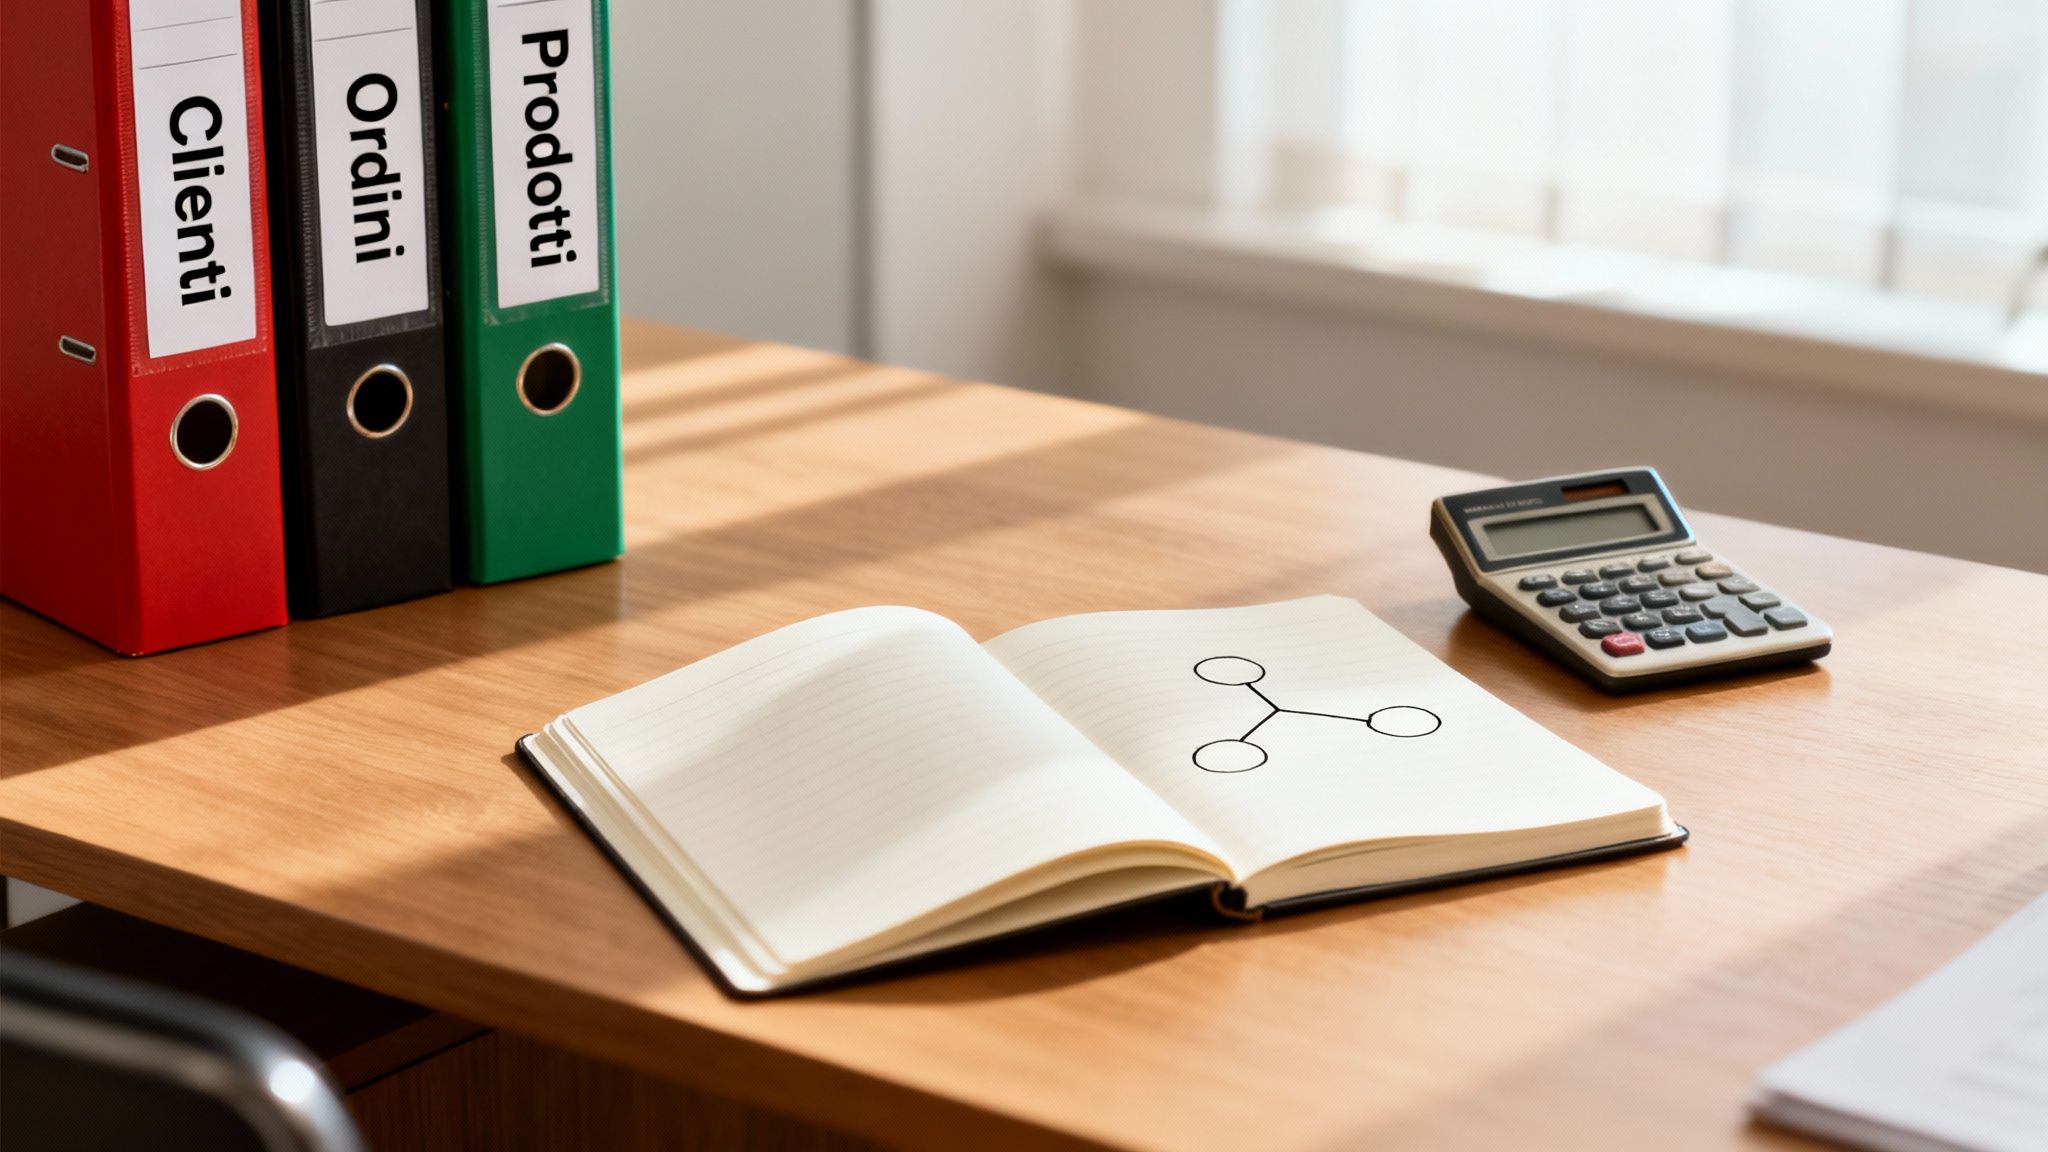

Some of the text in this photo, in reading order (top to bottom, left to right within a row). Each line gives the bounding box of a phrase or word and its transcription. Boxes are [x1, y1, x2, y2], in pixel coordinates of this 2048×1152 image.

[169, 95, 232, 307] Clienti
[346, 73, 405, 264] Ordini
[521, 28, 577, 268] Prodotti
